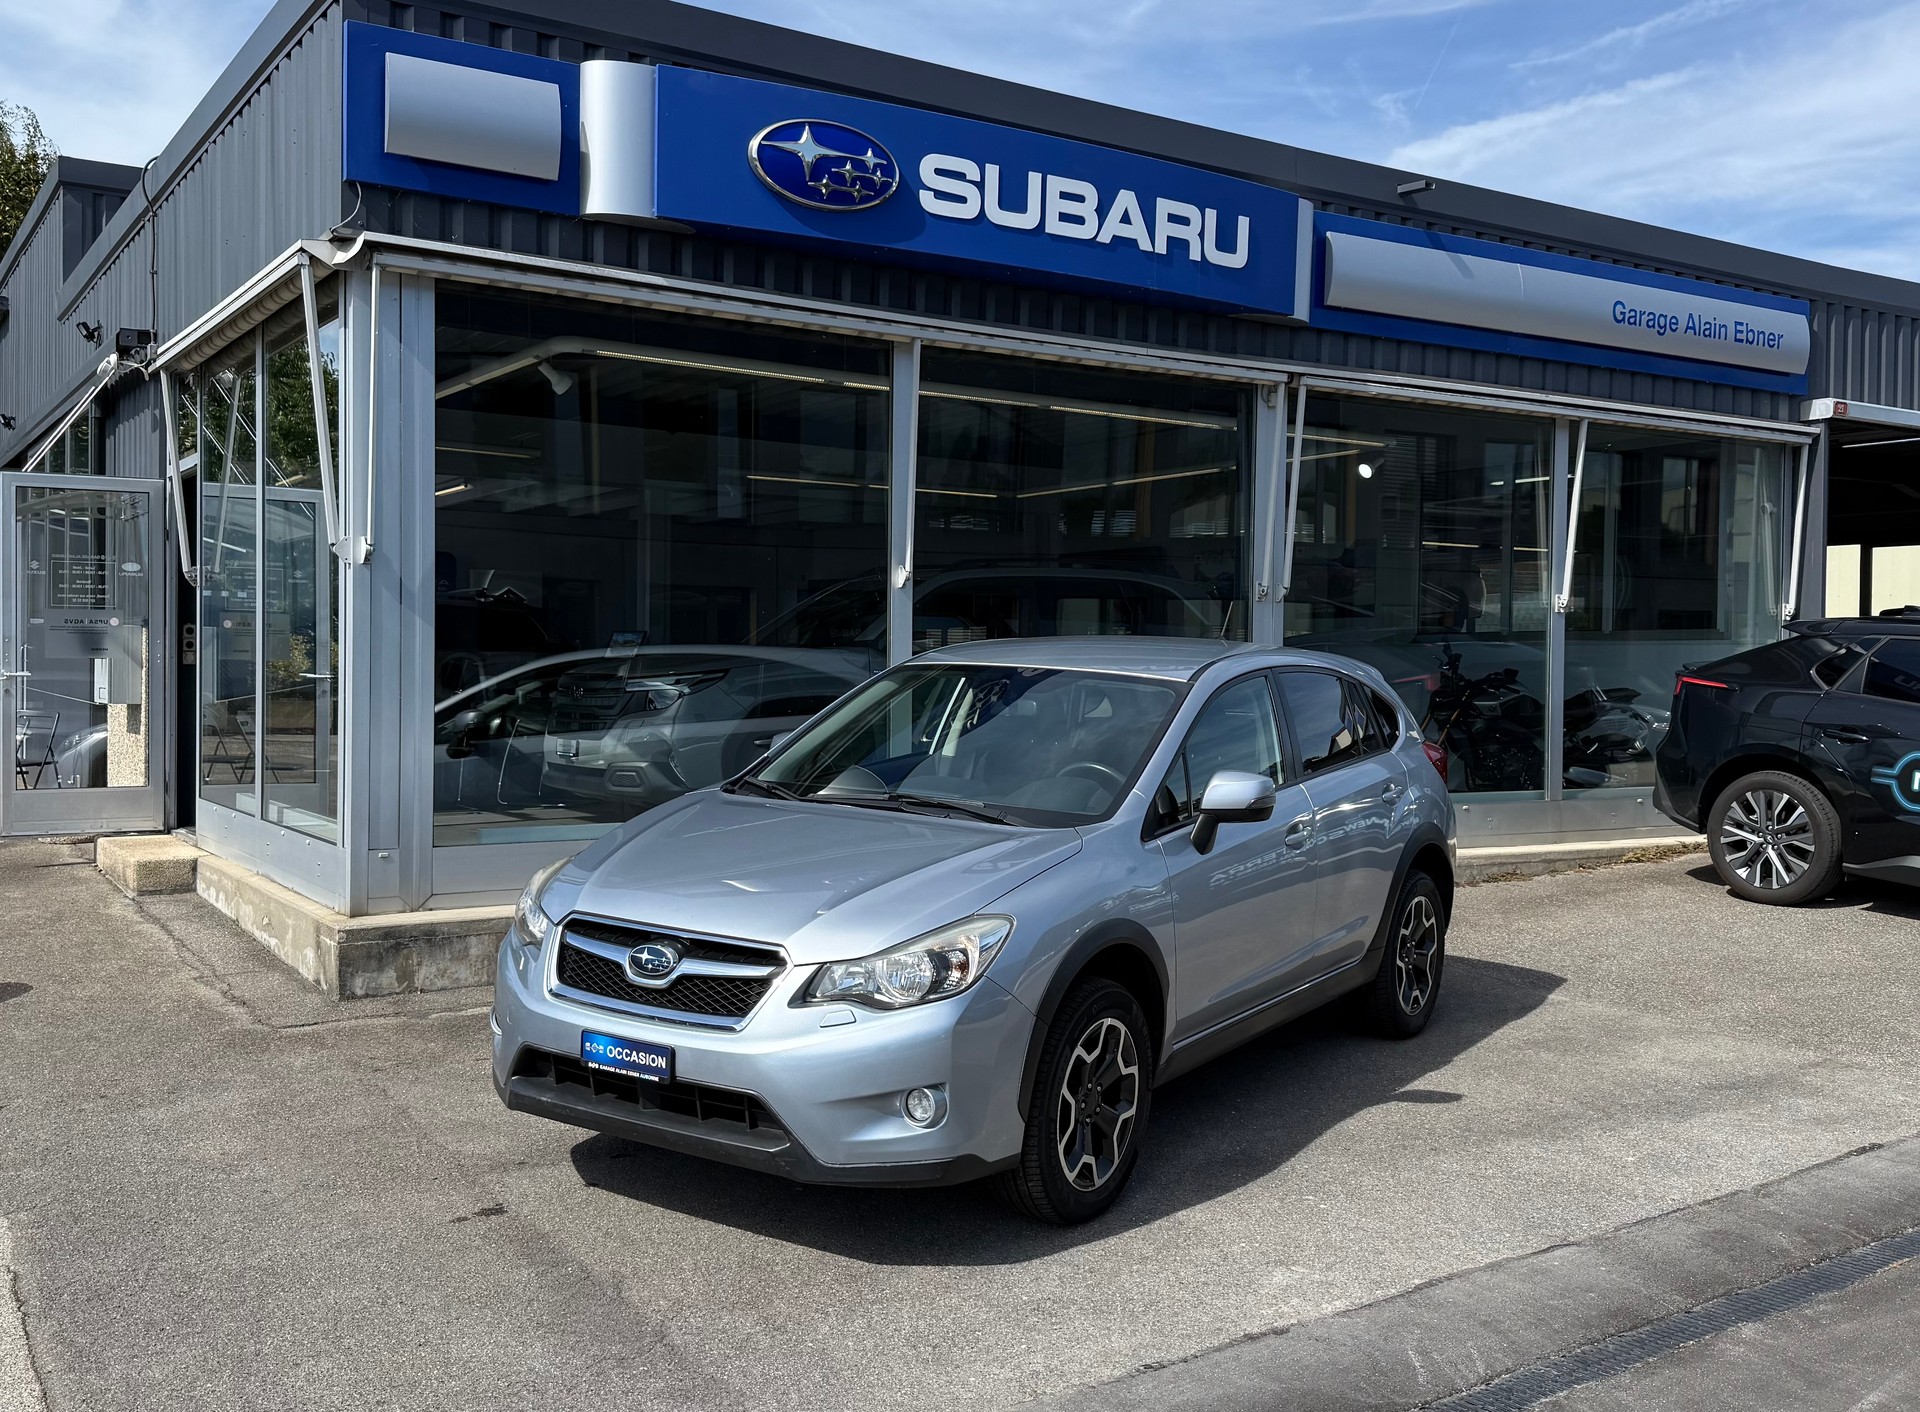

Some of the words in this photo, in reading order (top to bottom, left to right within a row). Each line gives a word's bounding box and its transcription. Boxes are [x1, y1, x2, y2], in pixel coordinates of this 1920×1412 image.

[919, 153, 1250, 269] SUBARU
[1612, 300, 1679, 336] Garage
[1684, 312, 1728, 341] Alain
[1733, 320, 1784, 350] Ebner
[606, 1046, 666, 1068] OCCASION
